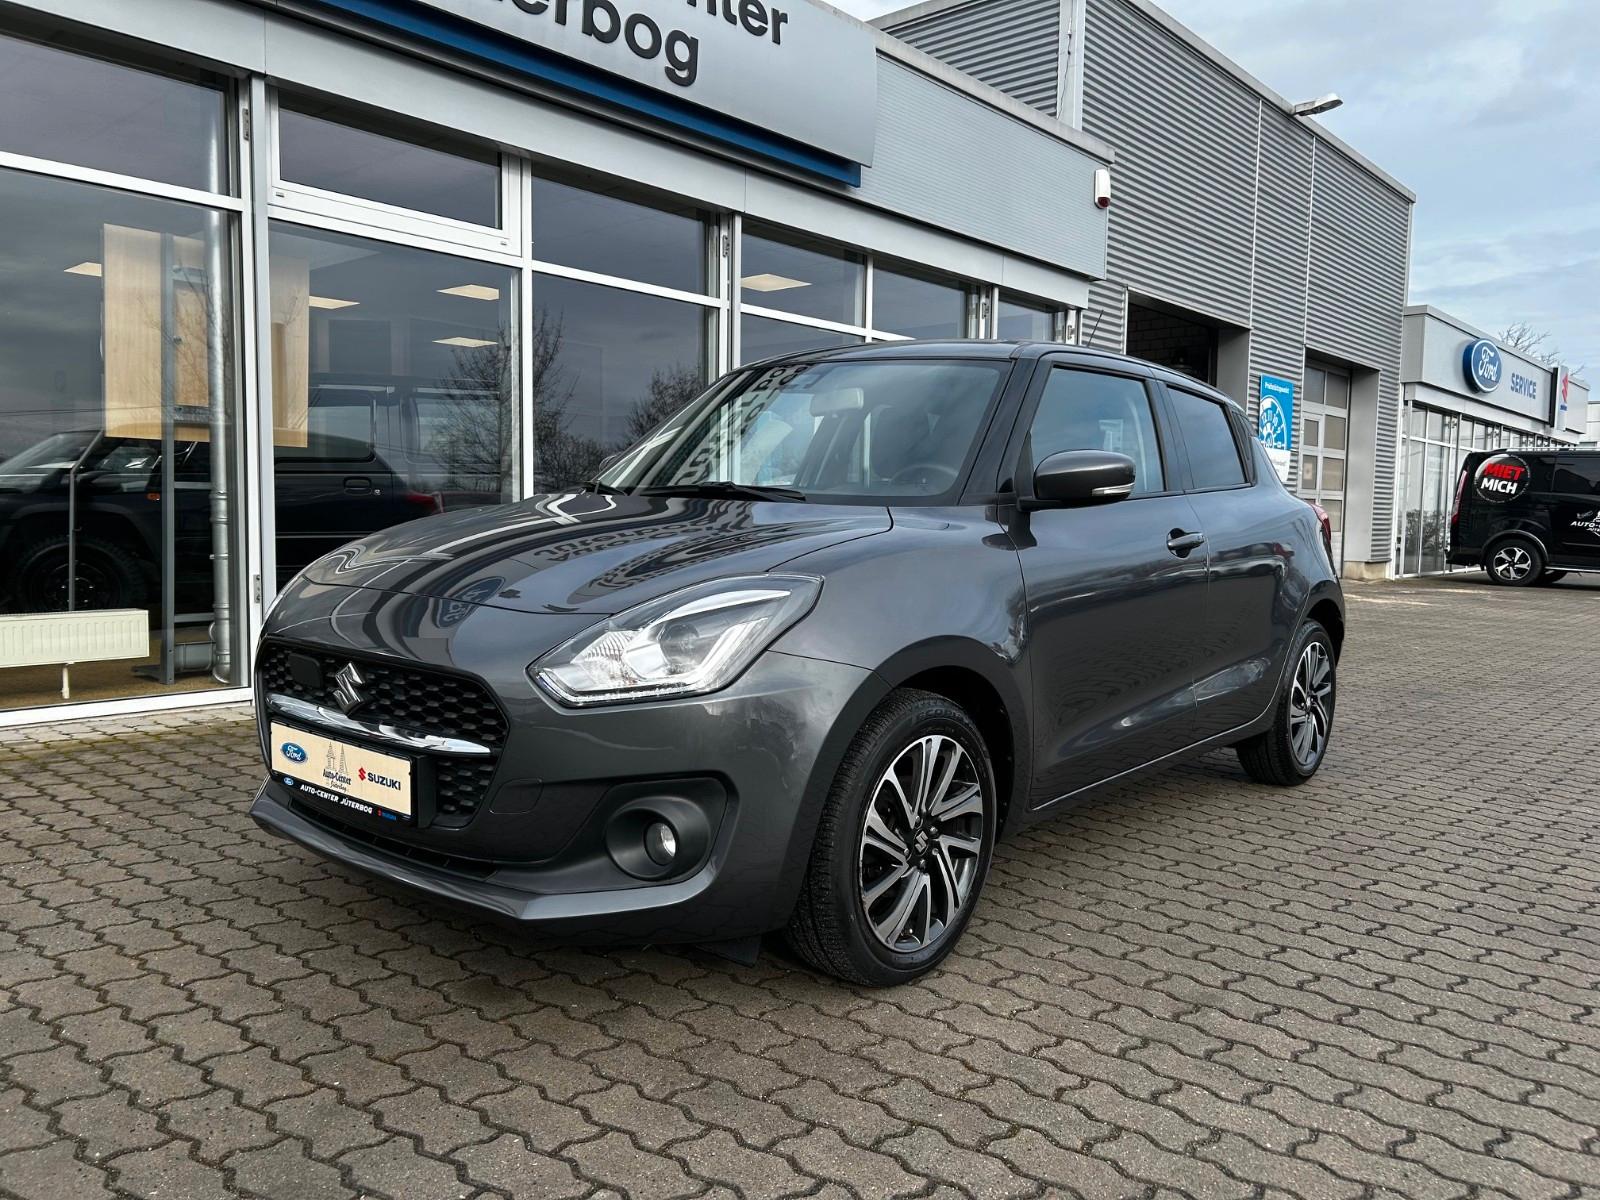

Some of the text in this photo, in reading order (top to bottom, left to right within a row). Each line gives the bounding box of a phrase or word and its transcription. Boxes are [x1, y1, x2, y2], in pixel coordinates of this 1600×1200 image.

[1478, 346, 1499, 383] Ford
[1510, 372, 1537, 400] SERVICE
[1483, 463, 1526, 481] MIET
[1480, 477, 1518, 495] MICH
[285, 745, 302, 762] Ford
[367, 772, 402, 791] SUZUKI
[300, 784, 374, 815] AUTO-CENTER JÜTERBOG
